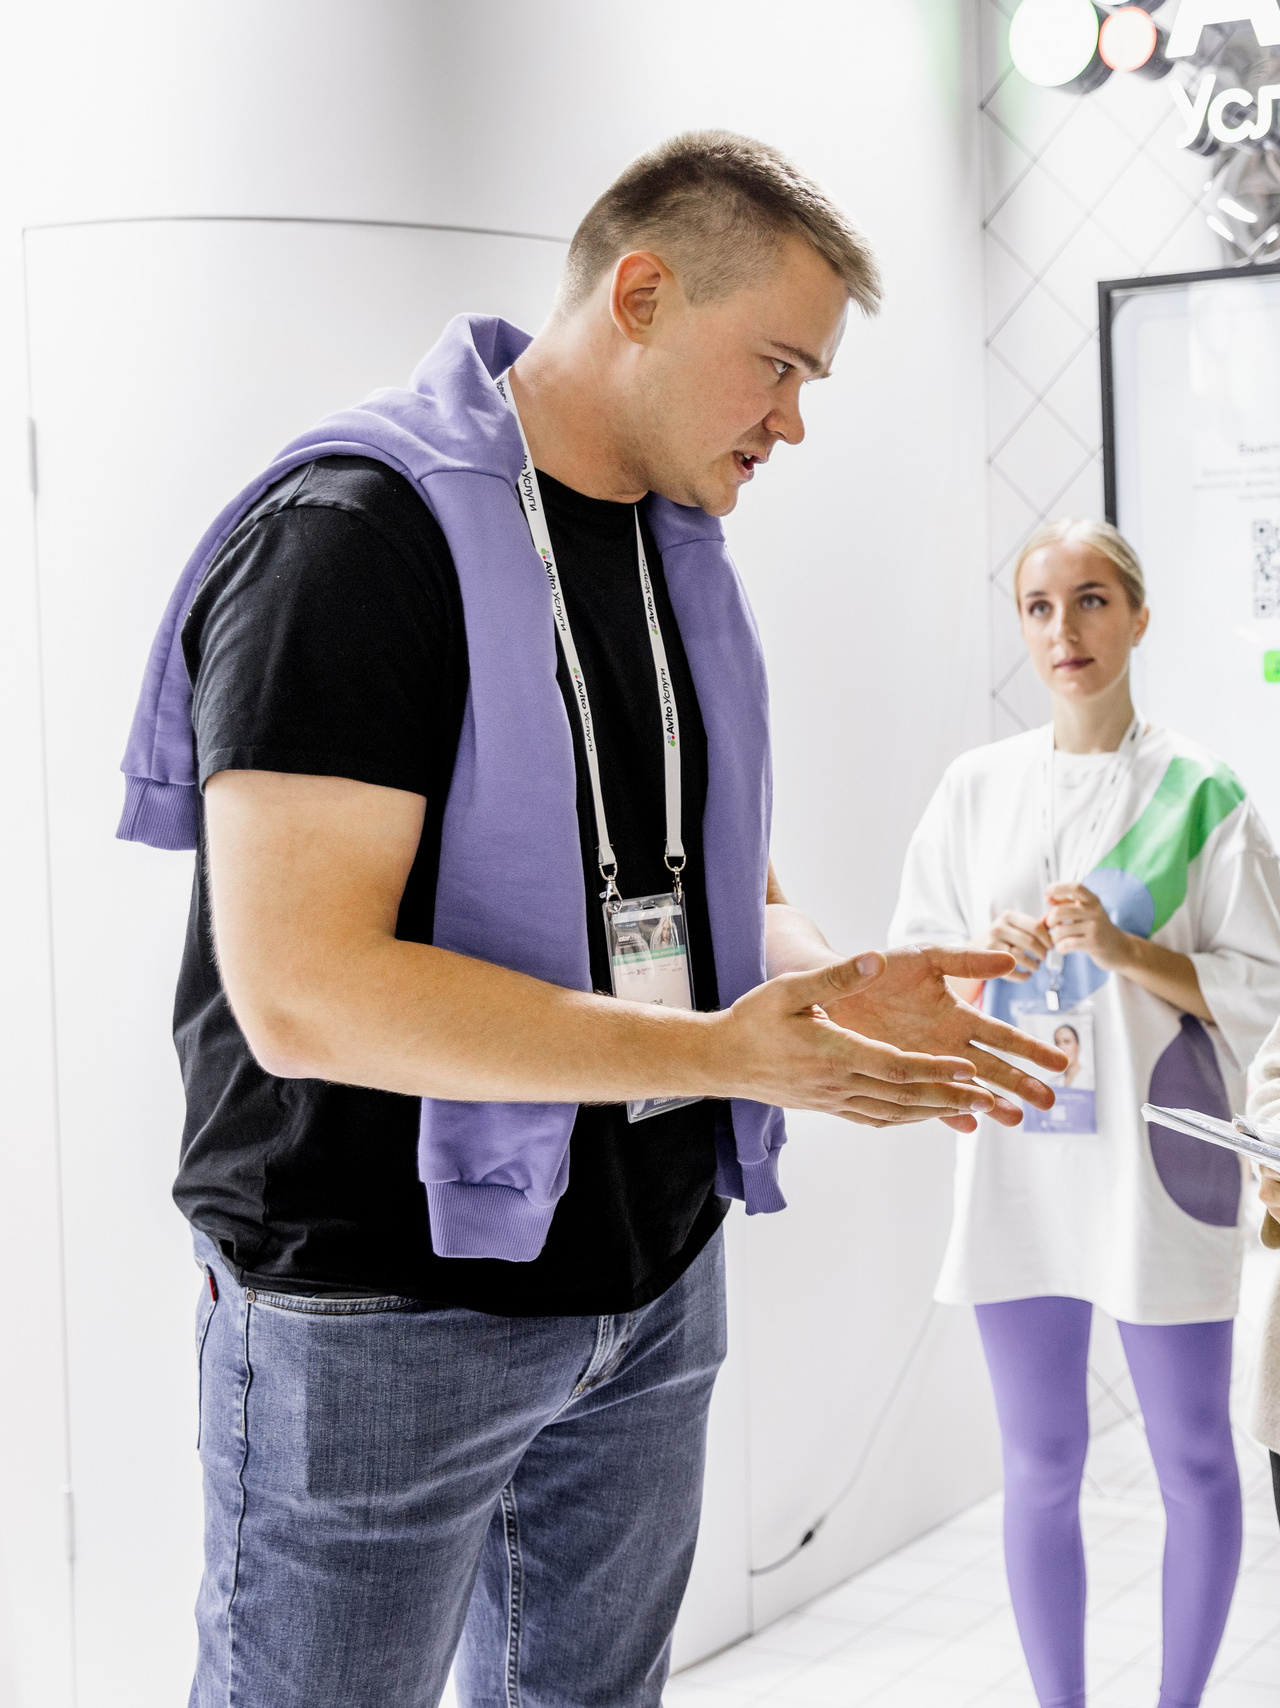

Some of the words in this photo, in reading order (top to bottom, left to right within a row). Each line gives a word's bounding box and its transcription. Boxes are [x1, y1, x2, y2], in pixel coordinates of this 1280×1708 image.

[521, 470, 538, 512] Услуги
[641, 559, 652, 594] Услуги
[543, 560, 557, 590] Avito
[552, 591, 567, 632] Услуги
[647, 596, 657, 623] Avito
[660, 667, 672, 704] Услуги
[575, 679, 587, 710] Avito
[583, 711, 594, 752] Услуги
[666, 706, 675, 735] Avito
